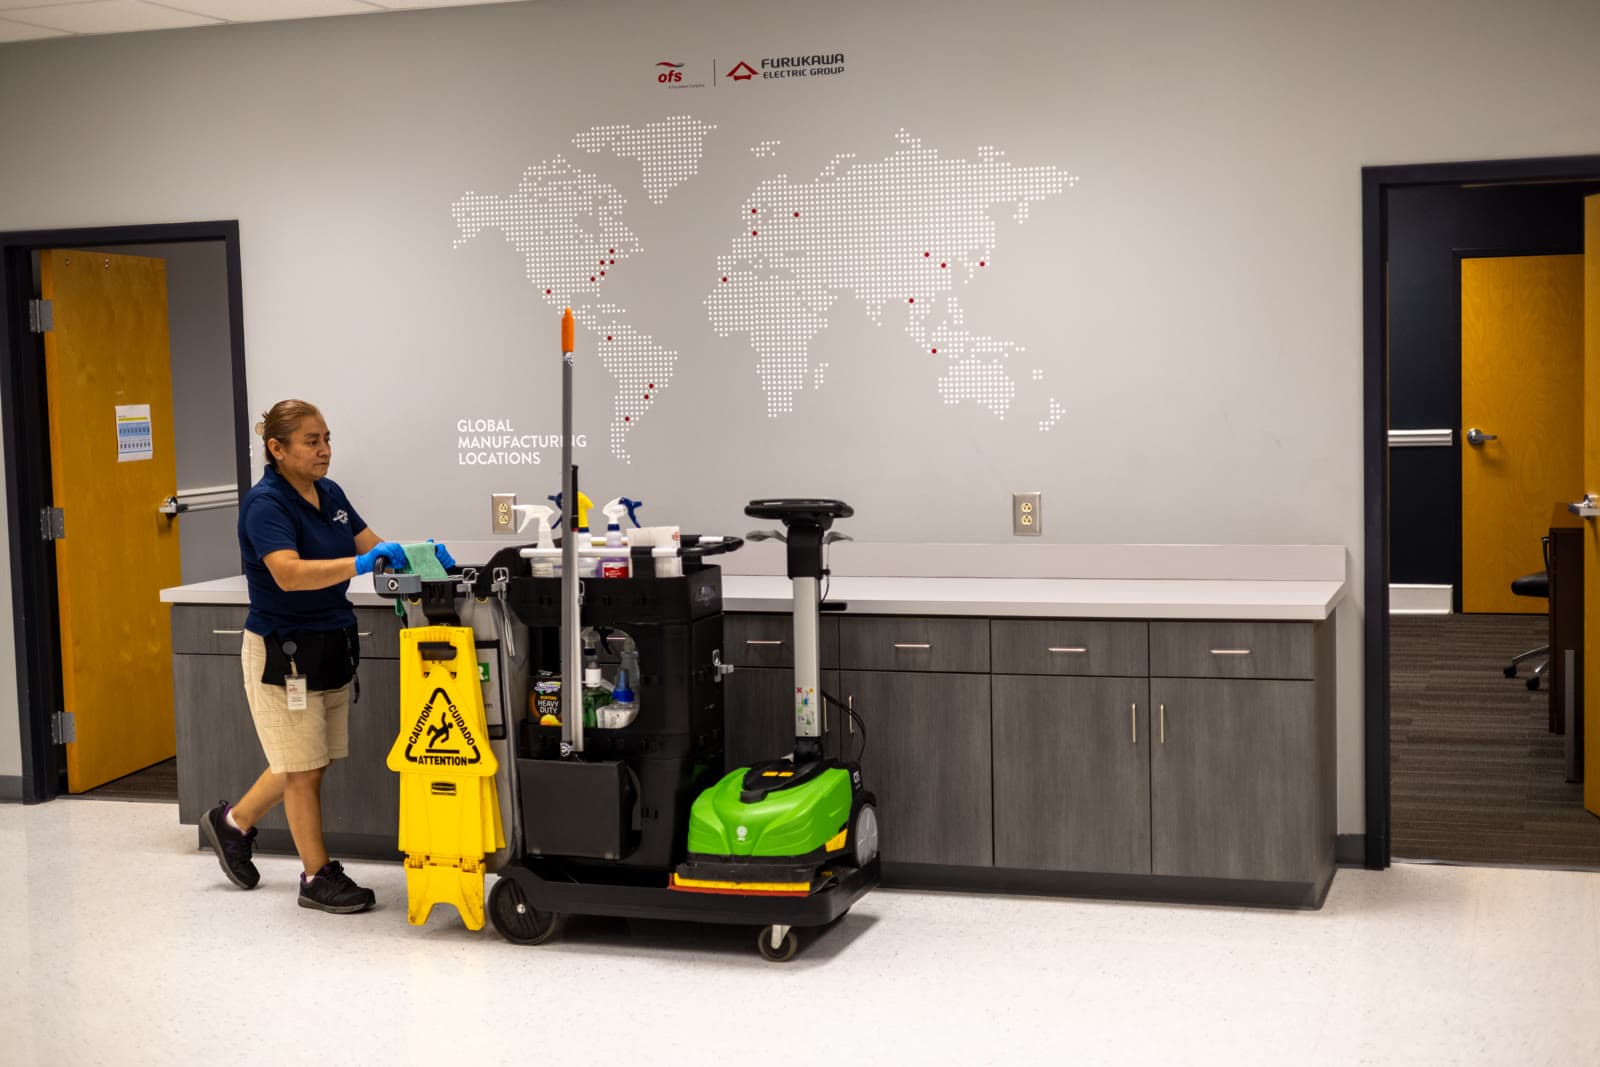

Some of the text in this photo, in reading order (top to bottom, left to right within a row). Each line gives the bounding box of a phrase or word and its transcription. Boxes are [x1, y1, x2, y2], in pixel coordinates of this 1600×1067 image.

[761, 53, 845, 69] FURUKAWA
[658, 70, 682, 83] ofs
[763, 66, 845, 79] ELECTRIC GROUP
[457, 419, 514, 432] GLOBAL
[458, 434, 587, 448] MANUFACTURIG
[458, 452, 541, 465] LOCATIONS
[537, 699, 559, 707] HEAVY
[539, 706, 558, 714] DUTY
[409, 703, 433, 744] CAUTION
[448, 704, 475, 746] CUIDADO
[418, 755, 468, 766] ATTENTION
